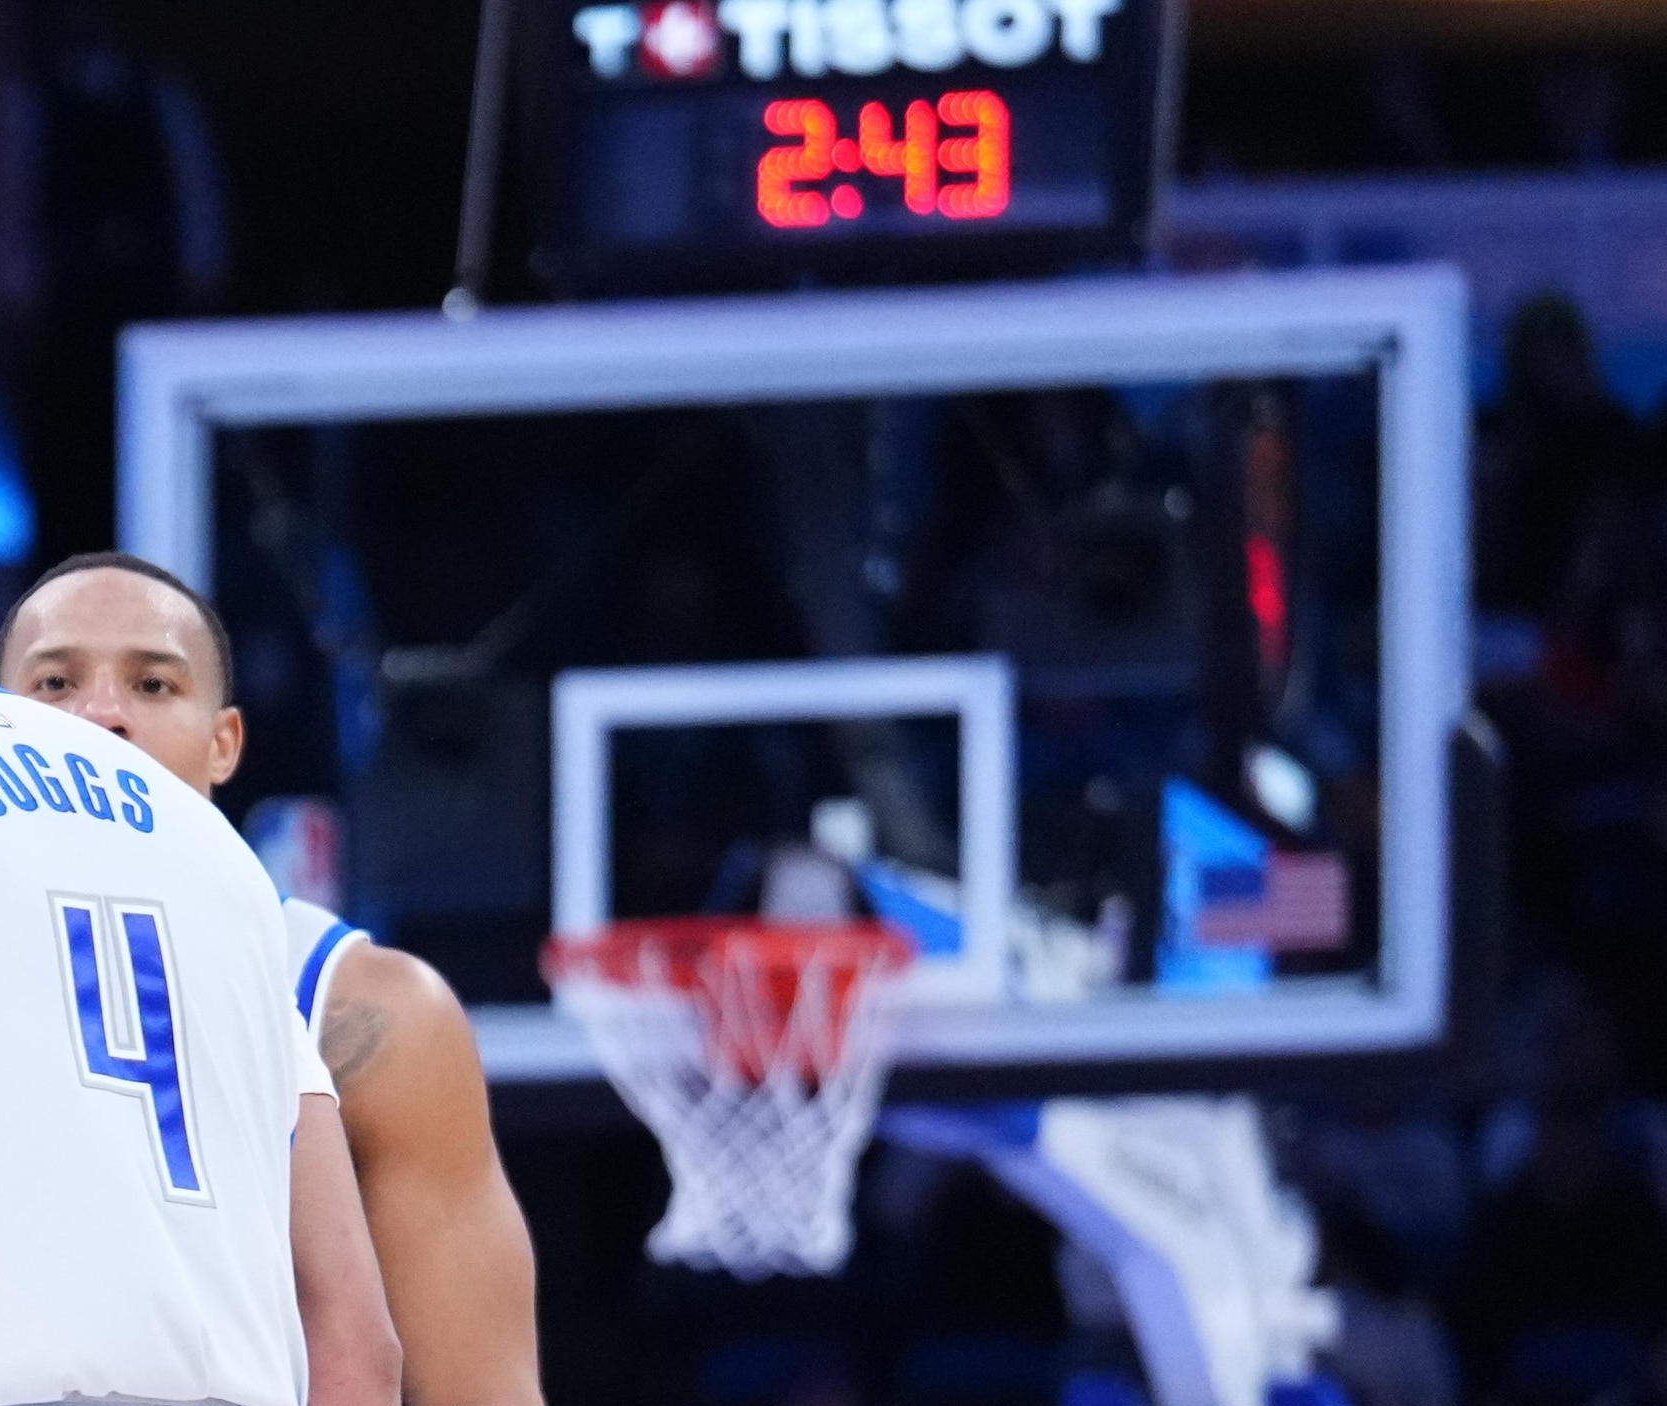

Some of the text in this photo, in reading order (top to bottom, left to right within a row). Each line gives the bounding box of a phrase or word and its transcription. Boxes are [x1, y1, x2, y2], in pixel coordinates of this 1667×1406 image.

[720, 0, 1124, 79] TISSOT
[758, 90, 1010, 228] 2:43
[49, 891, 214, 1207] 4
